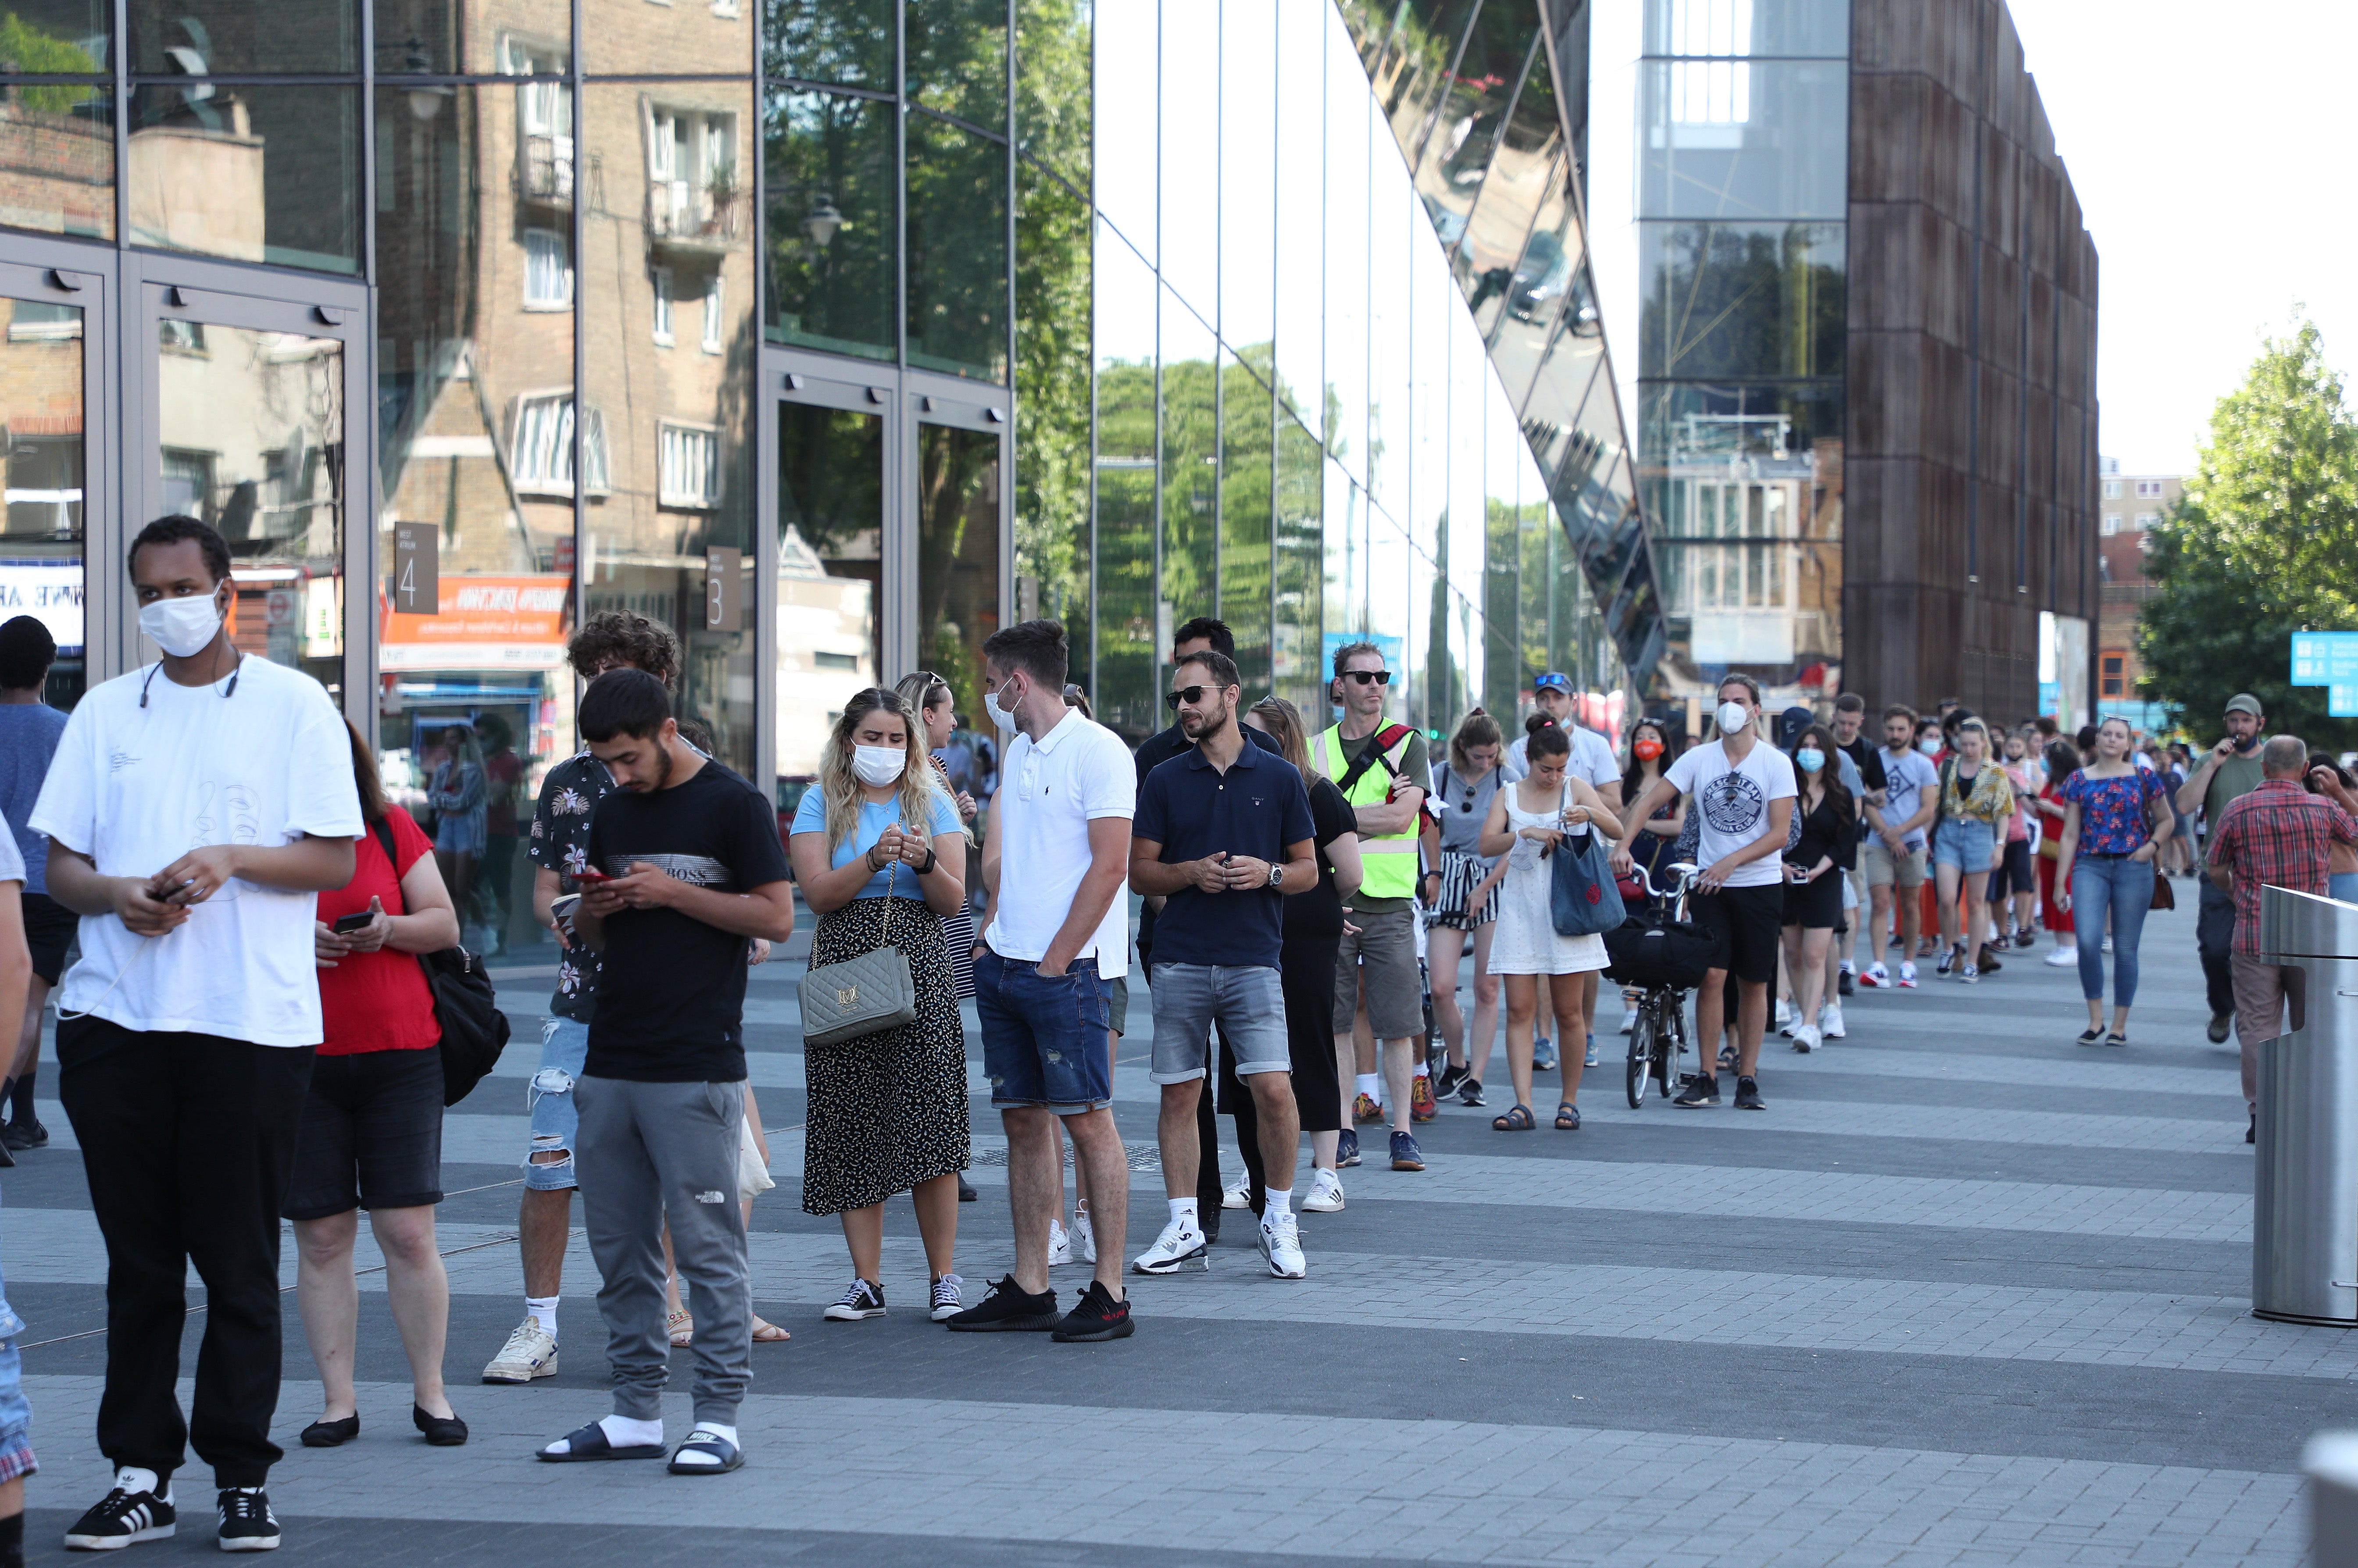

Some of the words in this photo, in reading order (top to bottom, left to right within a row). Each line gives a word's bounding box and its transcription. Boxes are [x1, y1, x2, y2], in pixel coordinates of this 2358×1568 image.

[400, 557, 416, 607] 4
[710, 578, 722, 625] 3
[1746, 783, 1761, 801] BAY
[1708, 815, 1734, 832] MARINA
[1735, 816, 1755, 831] CLUB
[667, 867, 706, 880] BOSS
[688, 1431, 718, 1442] NIKE
